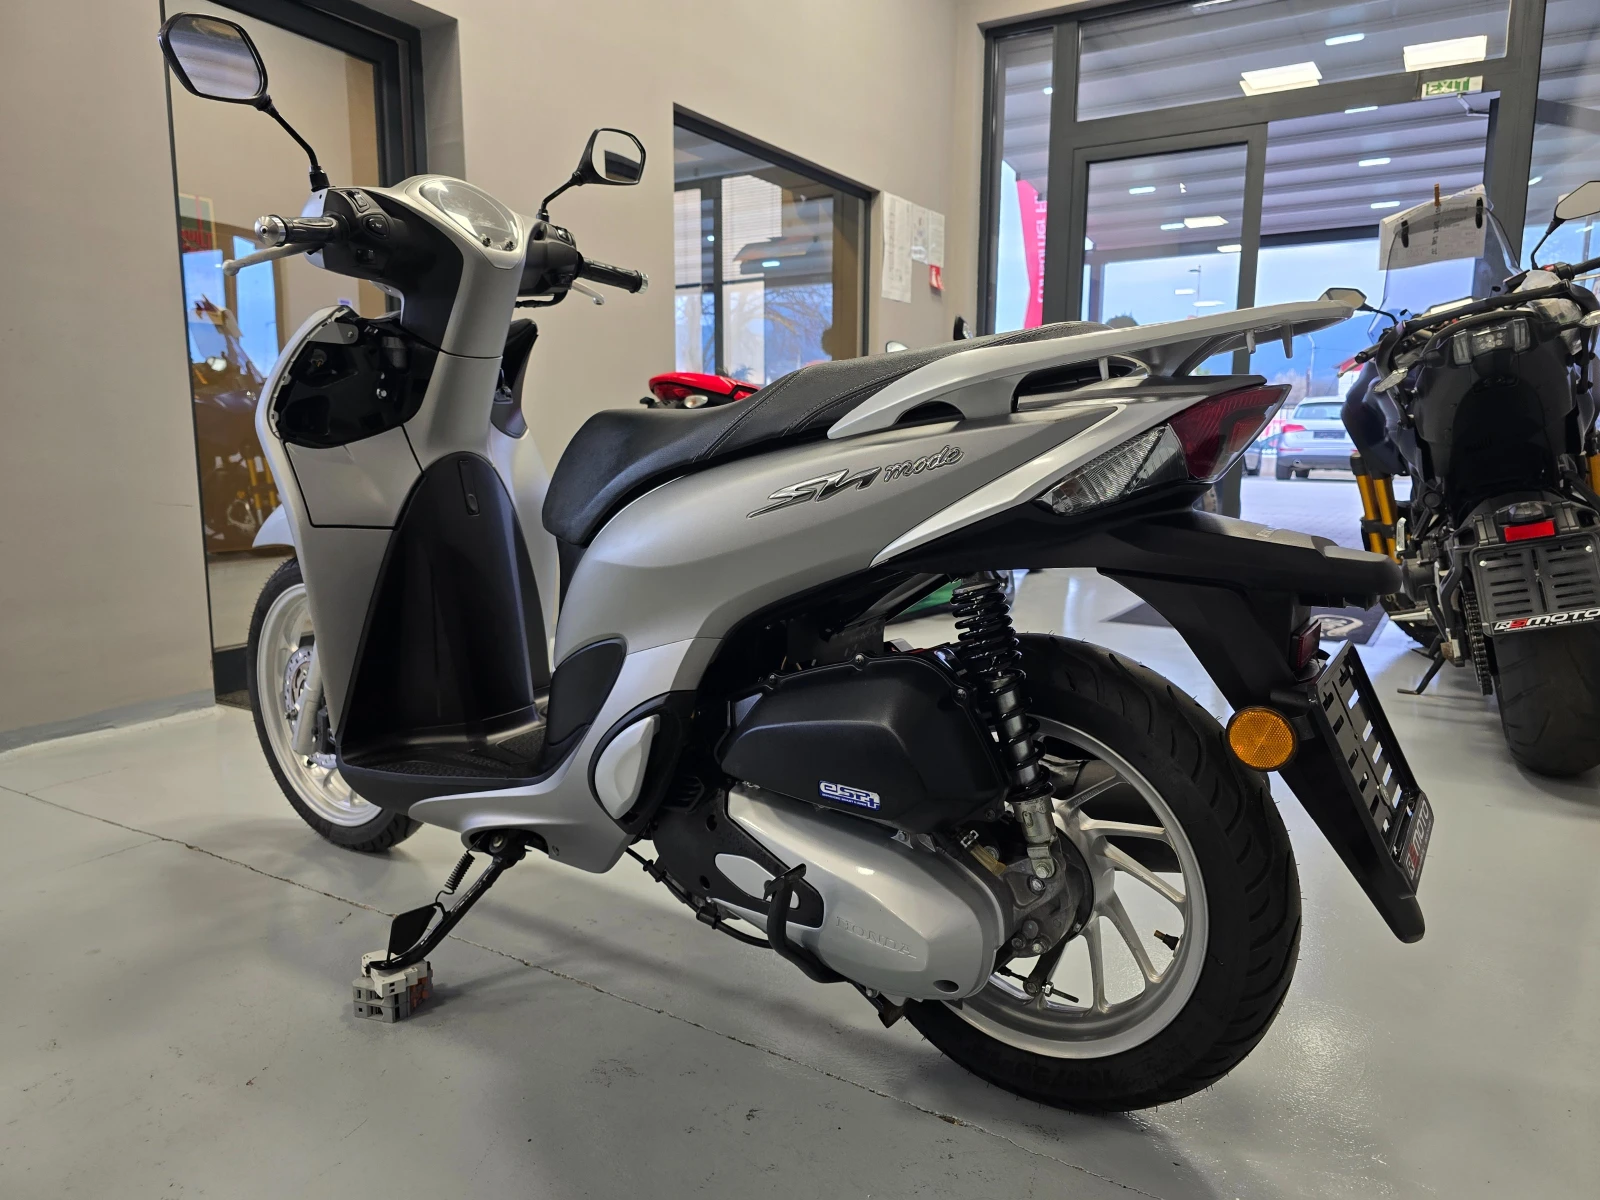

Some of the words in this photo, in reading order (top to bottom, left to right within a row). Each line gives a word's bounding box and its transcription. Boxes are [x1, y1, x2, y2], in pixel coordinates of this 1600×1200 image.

[1428, 77, 1469, 95] EXIT
[883, 444, 964, 482] mode
[835, 916, 917, 960] HONDA
